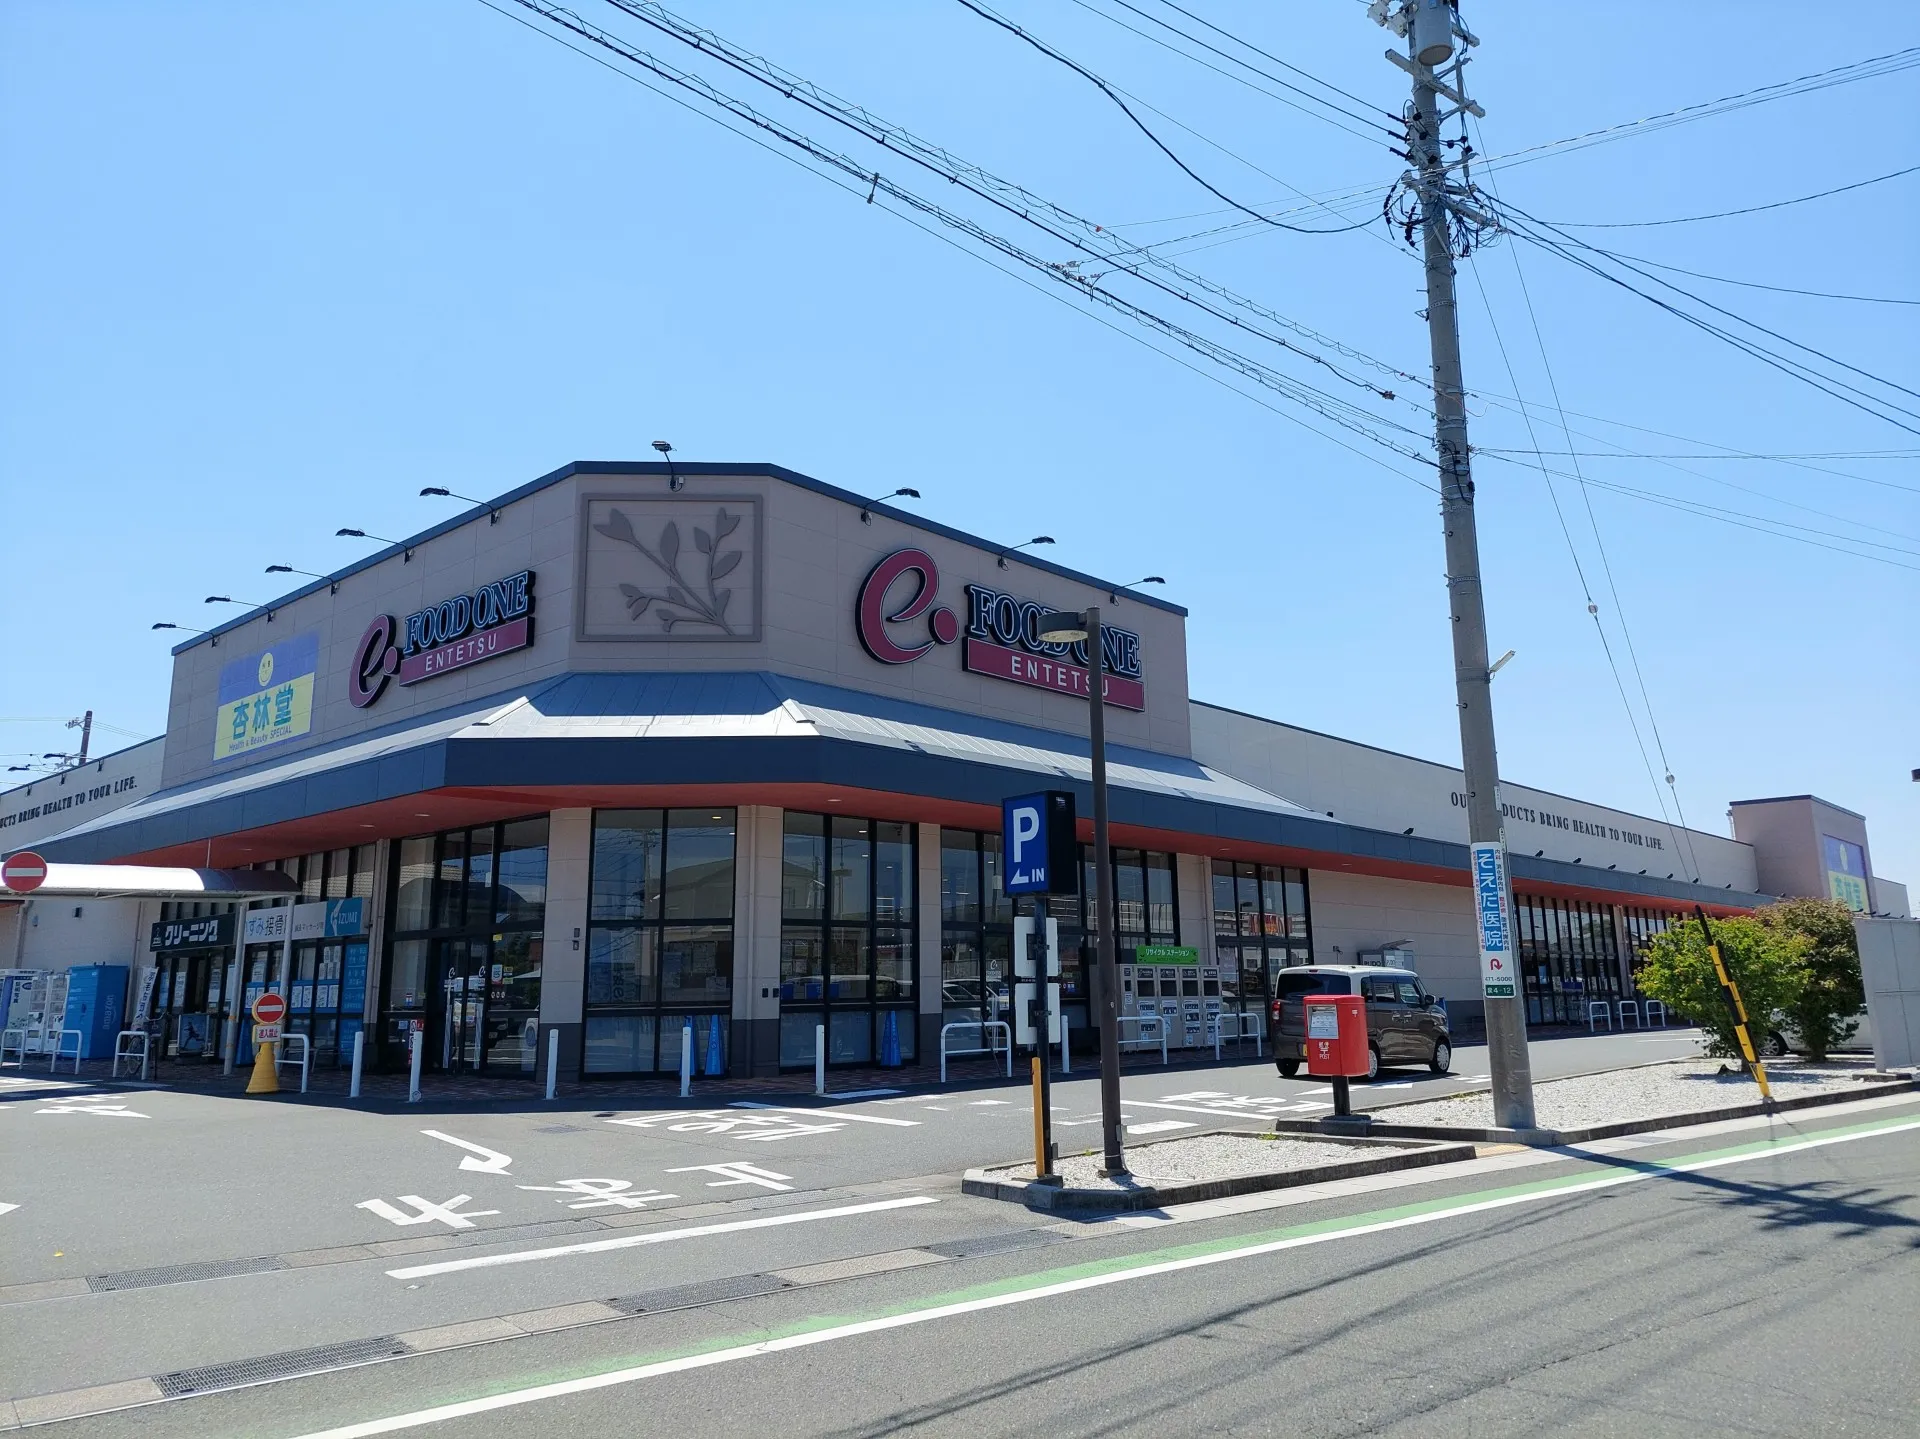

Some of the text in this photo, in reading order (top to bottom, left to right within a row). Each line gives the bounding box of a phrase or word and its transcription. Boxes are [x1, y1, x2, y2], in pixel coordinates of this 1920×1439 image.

[403, 571, 529, 654] FOOD ONE
[425, 633, 498, 672] ENTETSU
[232, 682, 295, 741] 杏林堂
[269, 724, 292, 739] SPECIAL
[18, 805, 41, 824] BRING
[42, 795, 72, 816] HEALTH
[75, 791, 87, 806] TO
[88, 783, 111, 802] YOUR
[113, 775, 138, 795] LIFE.
[1012, 806, 1041, 864] P
[1451, 791, 1665, 851] OU DUCTS BRING HEALTH TO YOUR LIFE.
[1031, 867, 1045, 883] IN
[338, 911, 358, 925] IZUMI
[1478, 853, 1503, 947] そえだ医院
[164, 919, 218, 946] クリーニング
[245, 913, 288, 936] ずみ接骨
[1145, 948, 1190, 957] リサイクル ステーション
[102, 994, 114, 1030] amazon
